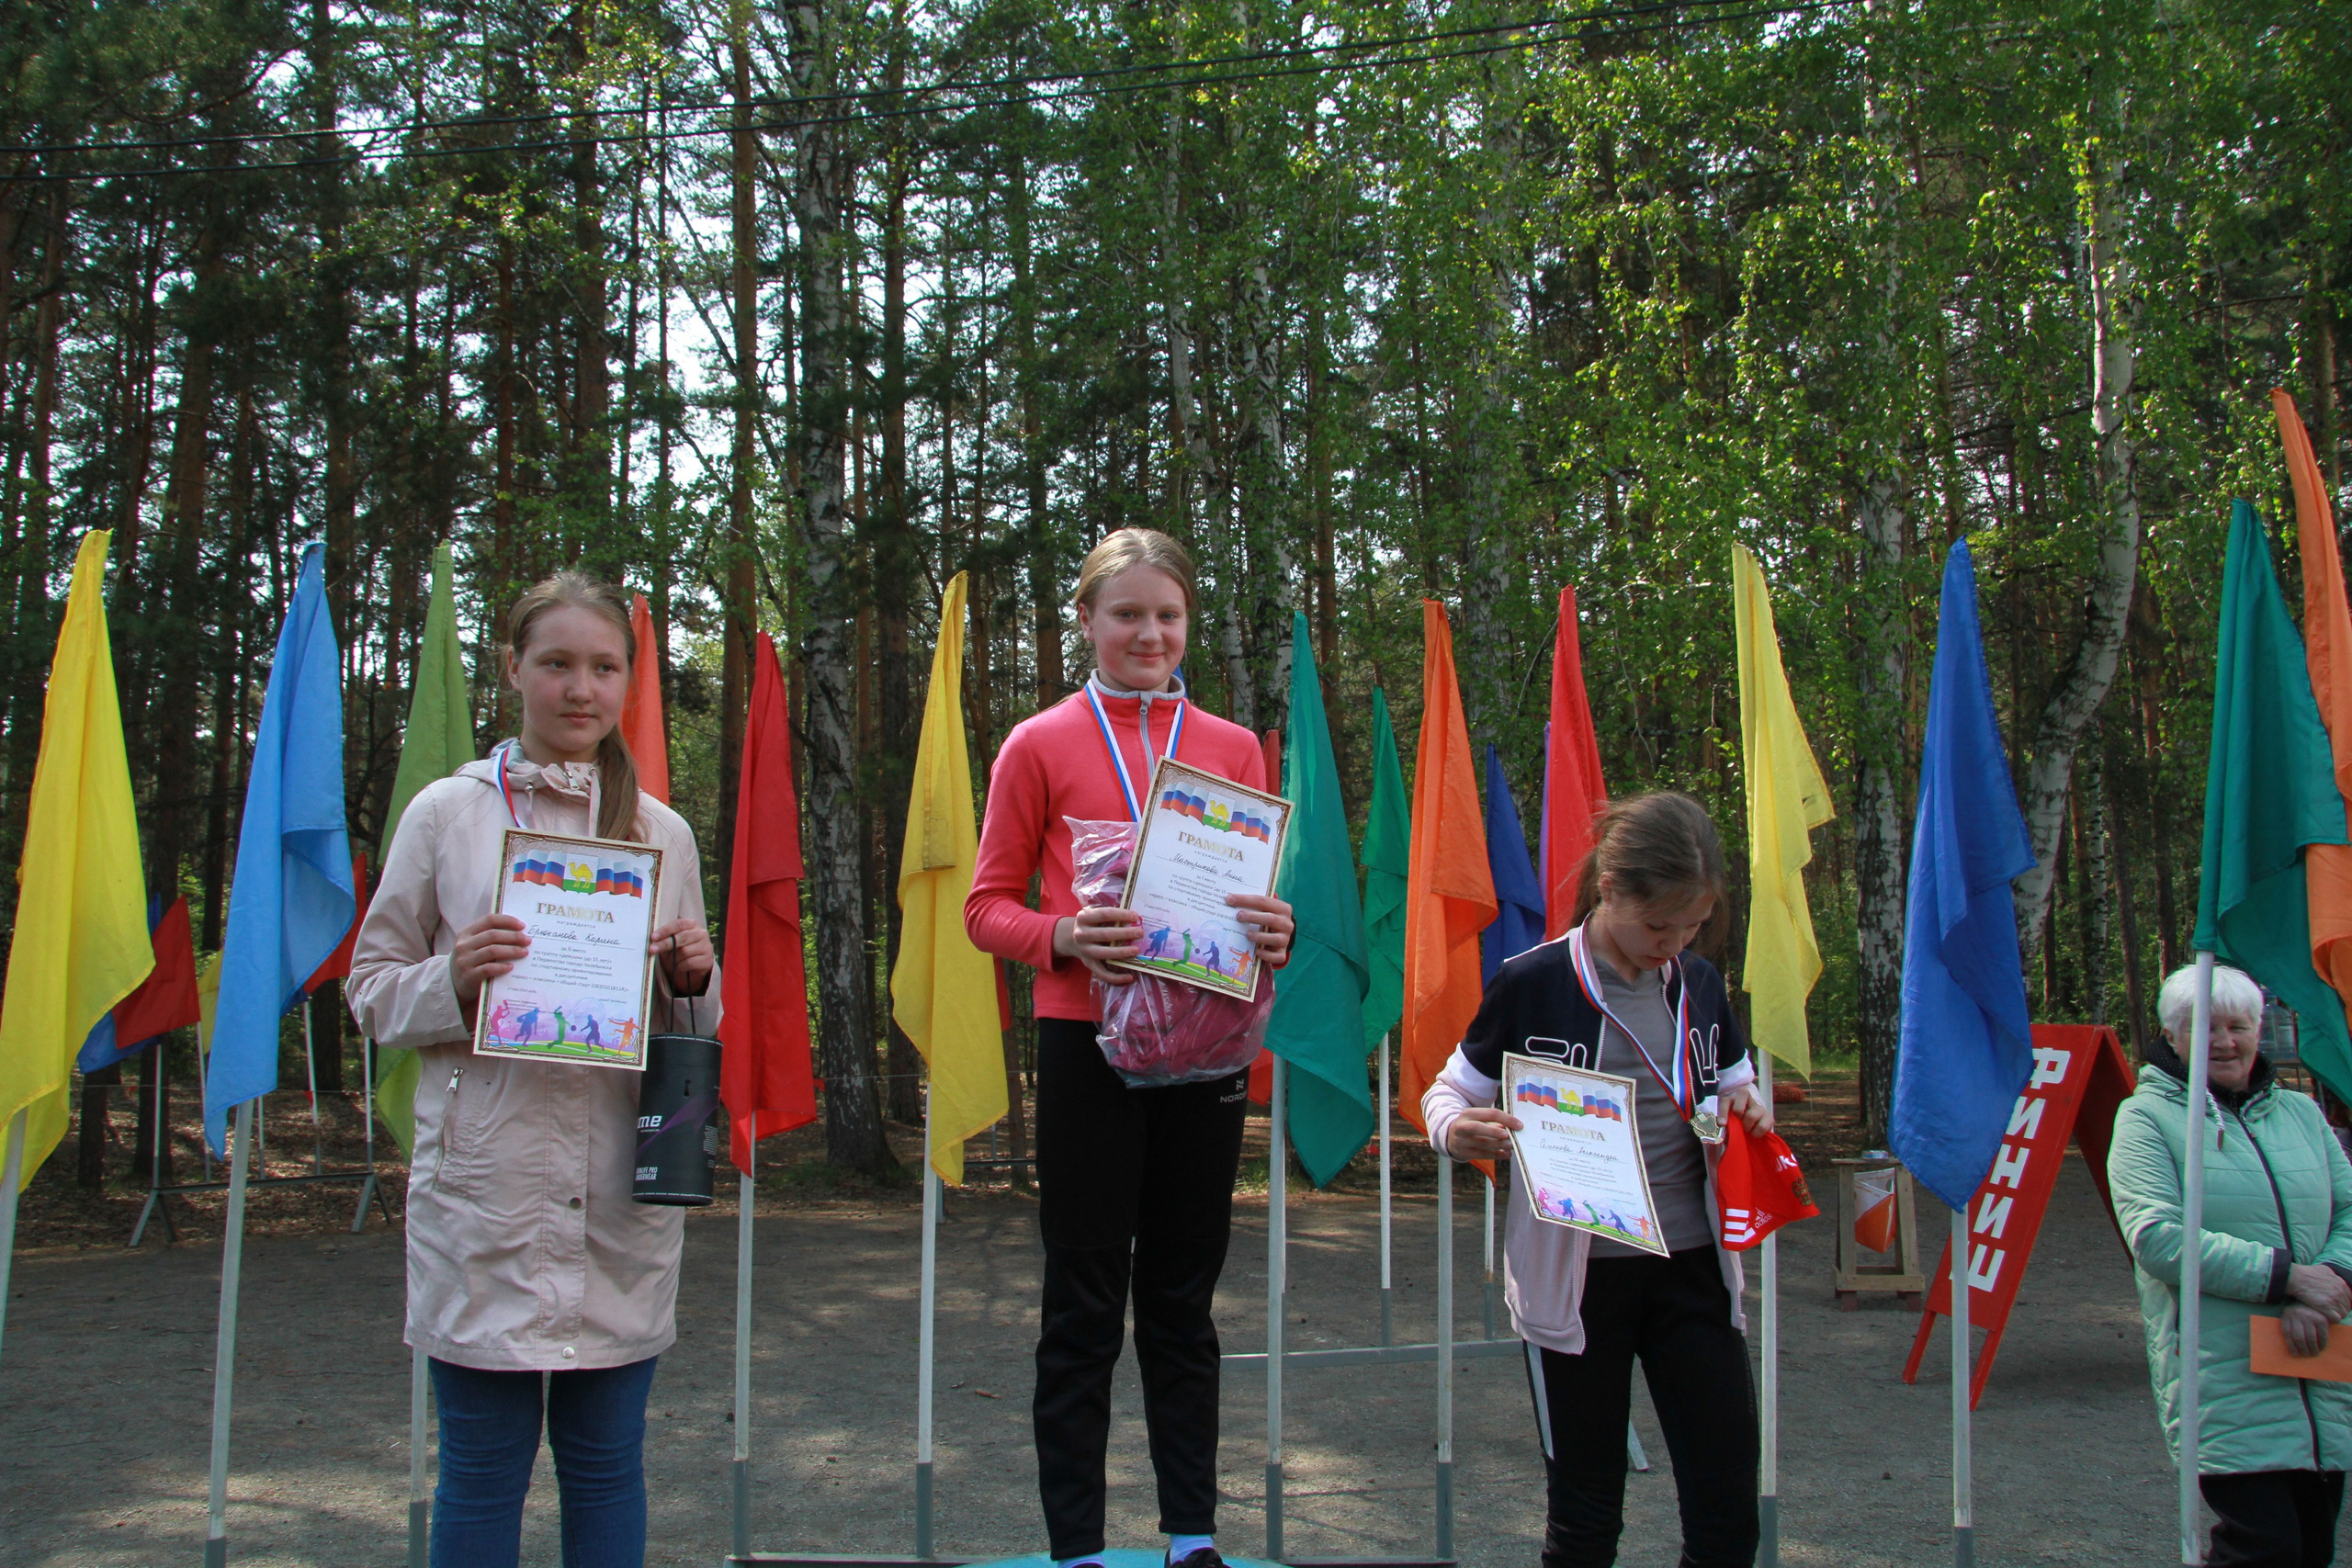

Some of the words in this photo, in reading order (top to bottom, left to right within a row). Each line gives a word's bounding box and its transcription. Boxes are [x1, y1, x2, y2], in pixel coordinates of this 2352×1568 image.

[1178, 831, 1244, 862] ГРАМОТА
[1194, 851, 1227, 863] награждается
[1222, 869, 1245, 882] Анна
[537, 902, 615, 922] ГРАМОТА
[585, 933, 621, 946] Карина
[1541, 1121, 1605, 1141] ГРАМОТА
[1949, 1047, 2071, 1292] ФИНИШ
